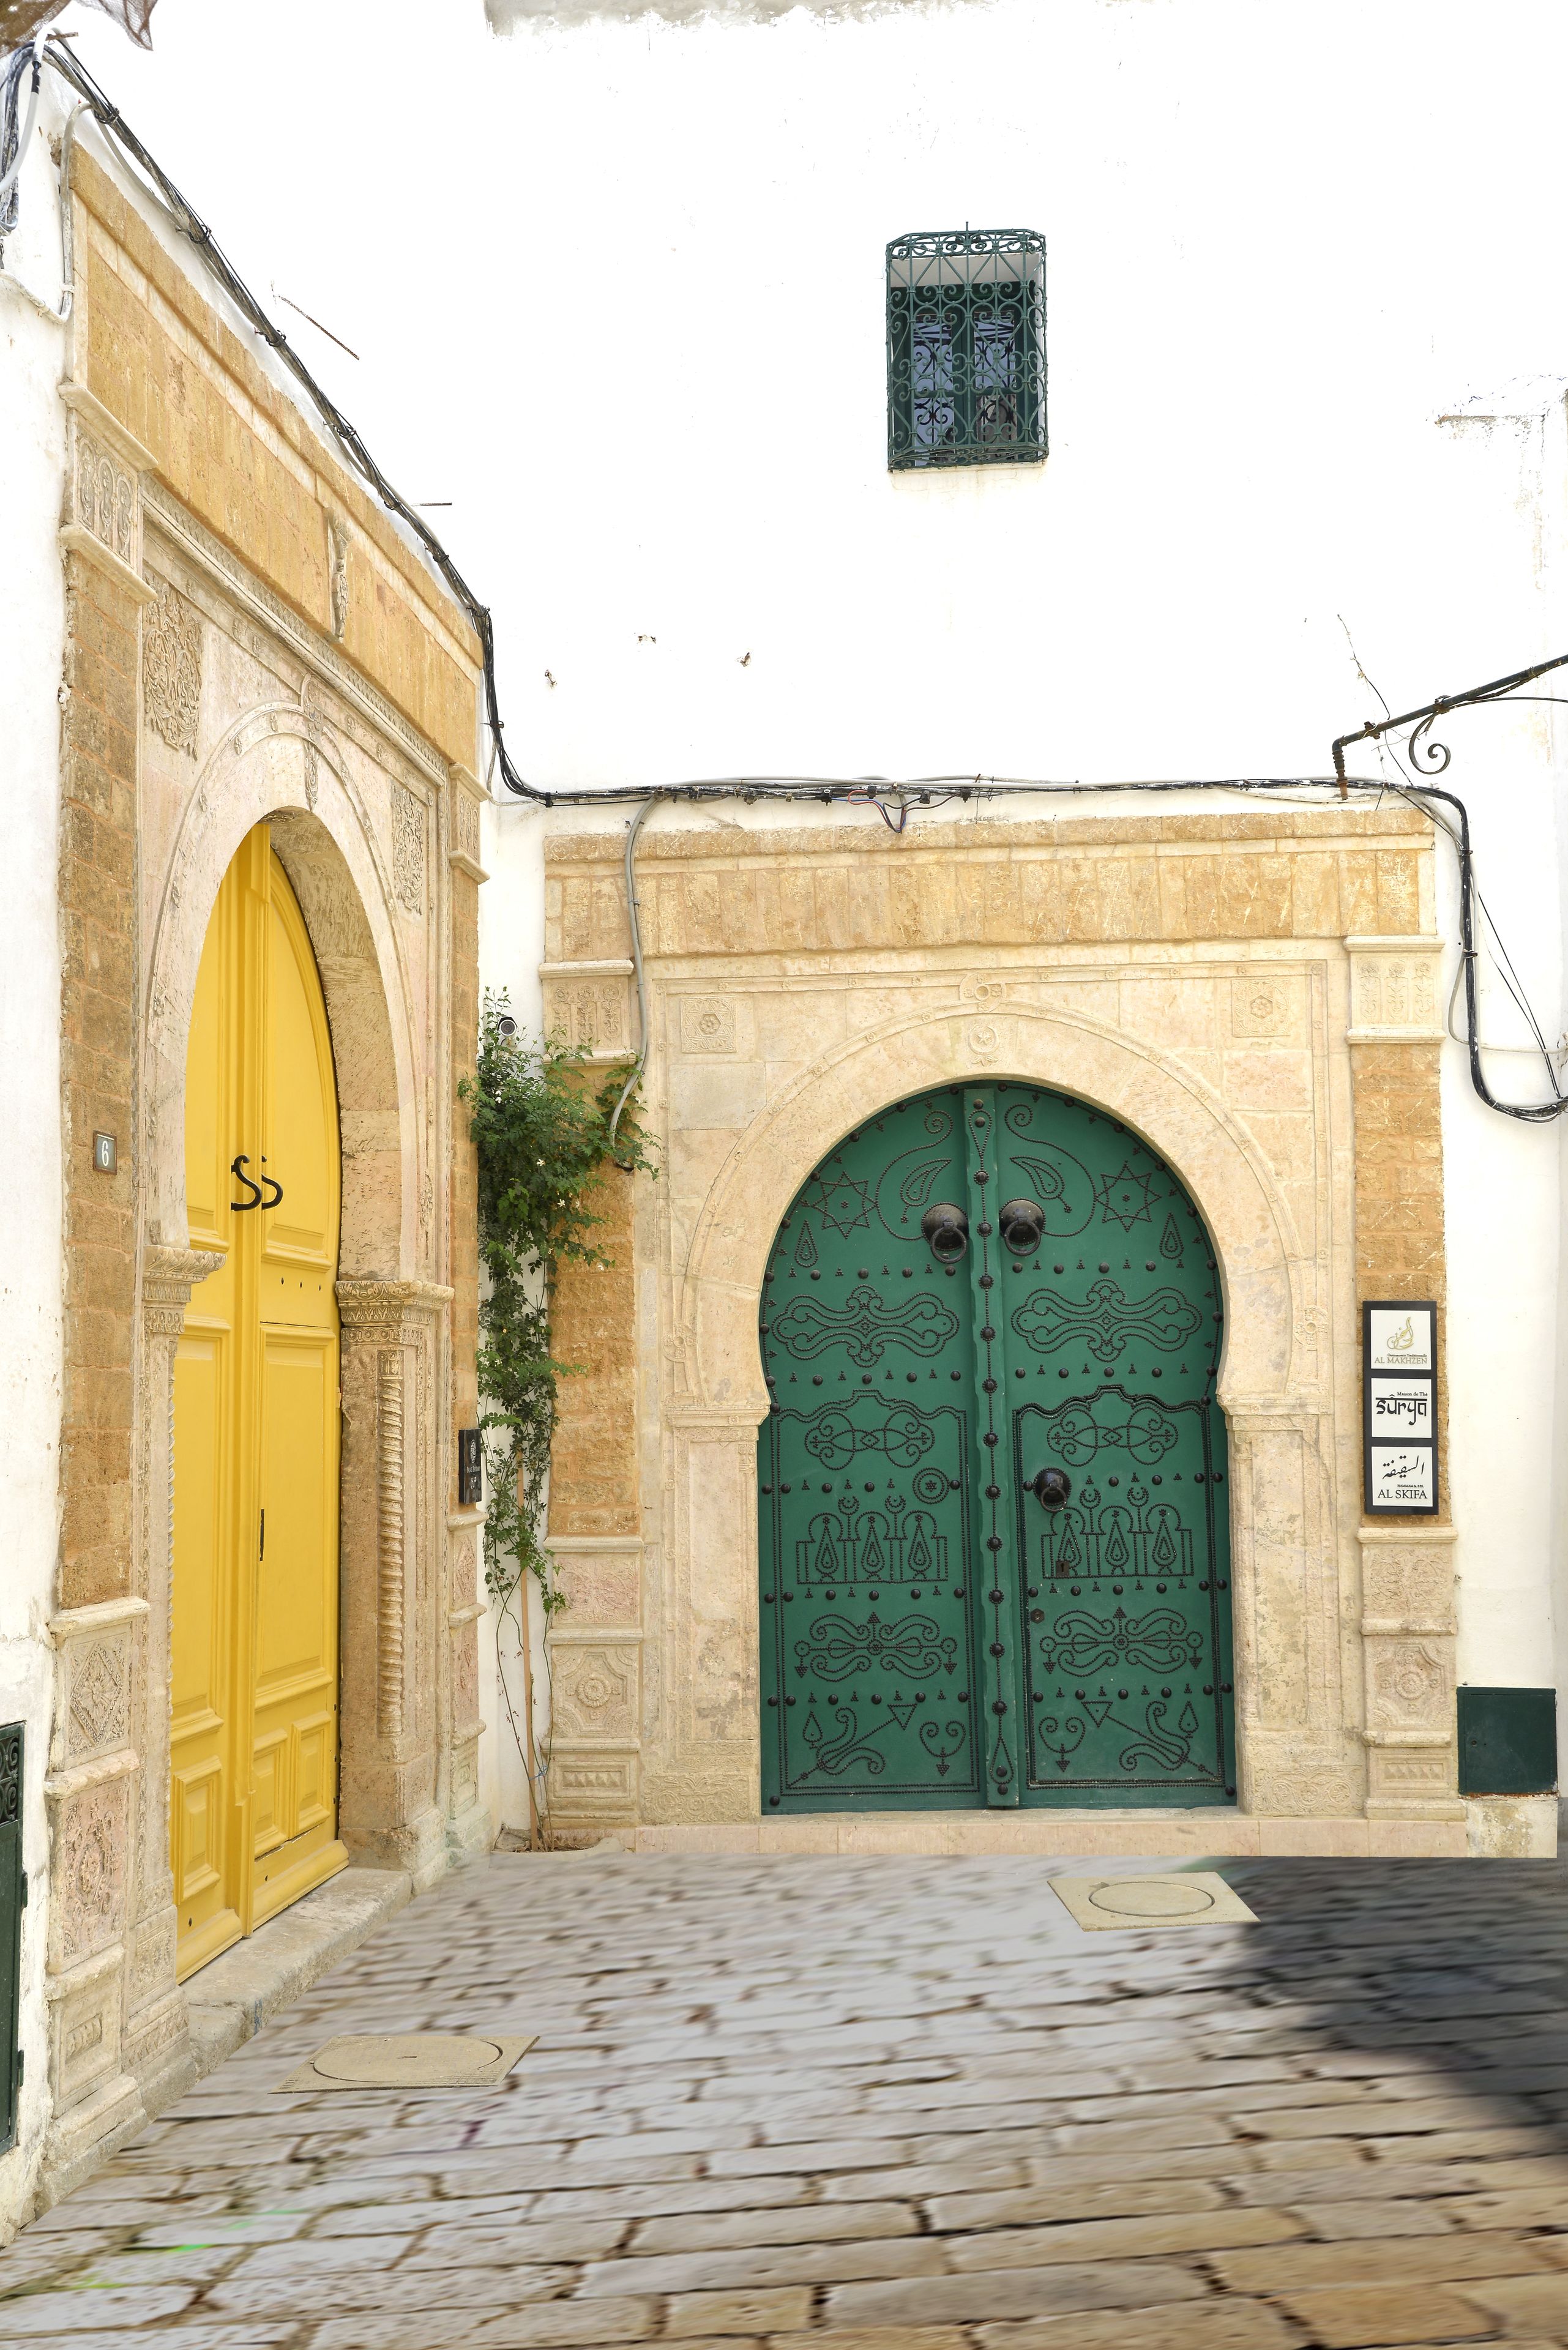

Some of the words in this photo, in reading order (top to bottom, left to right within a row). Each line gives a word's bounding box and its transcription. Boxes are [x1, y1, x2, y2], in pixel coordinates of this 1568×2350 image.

[102, 1140, 109, 1166] 6
[1382, 1455, 1425, 1479] السقيفة
[1378, 1489, 1394, 1498] AL
[1395, 1490, 1428, 1499] SKIFA
